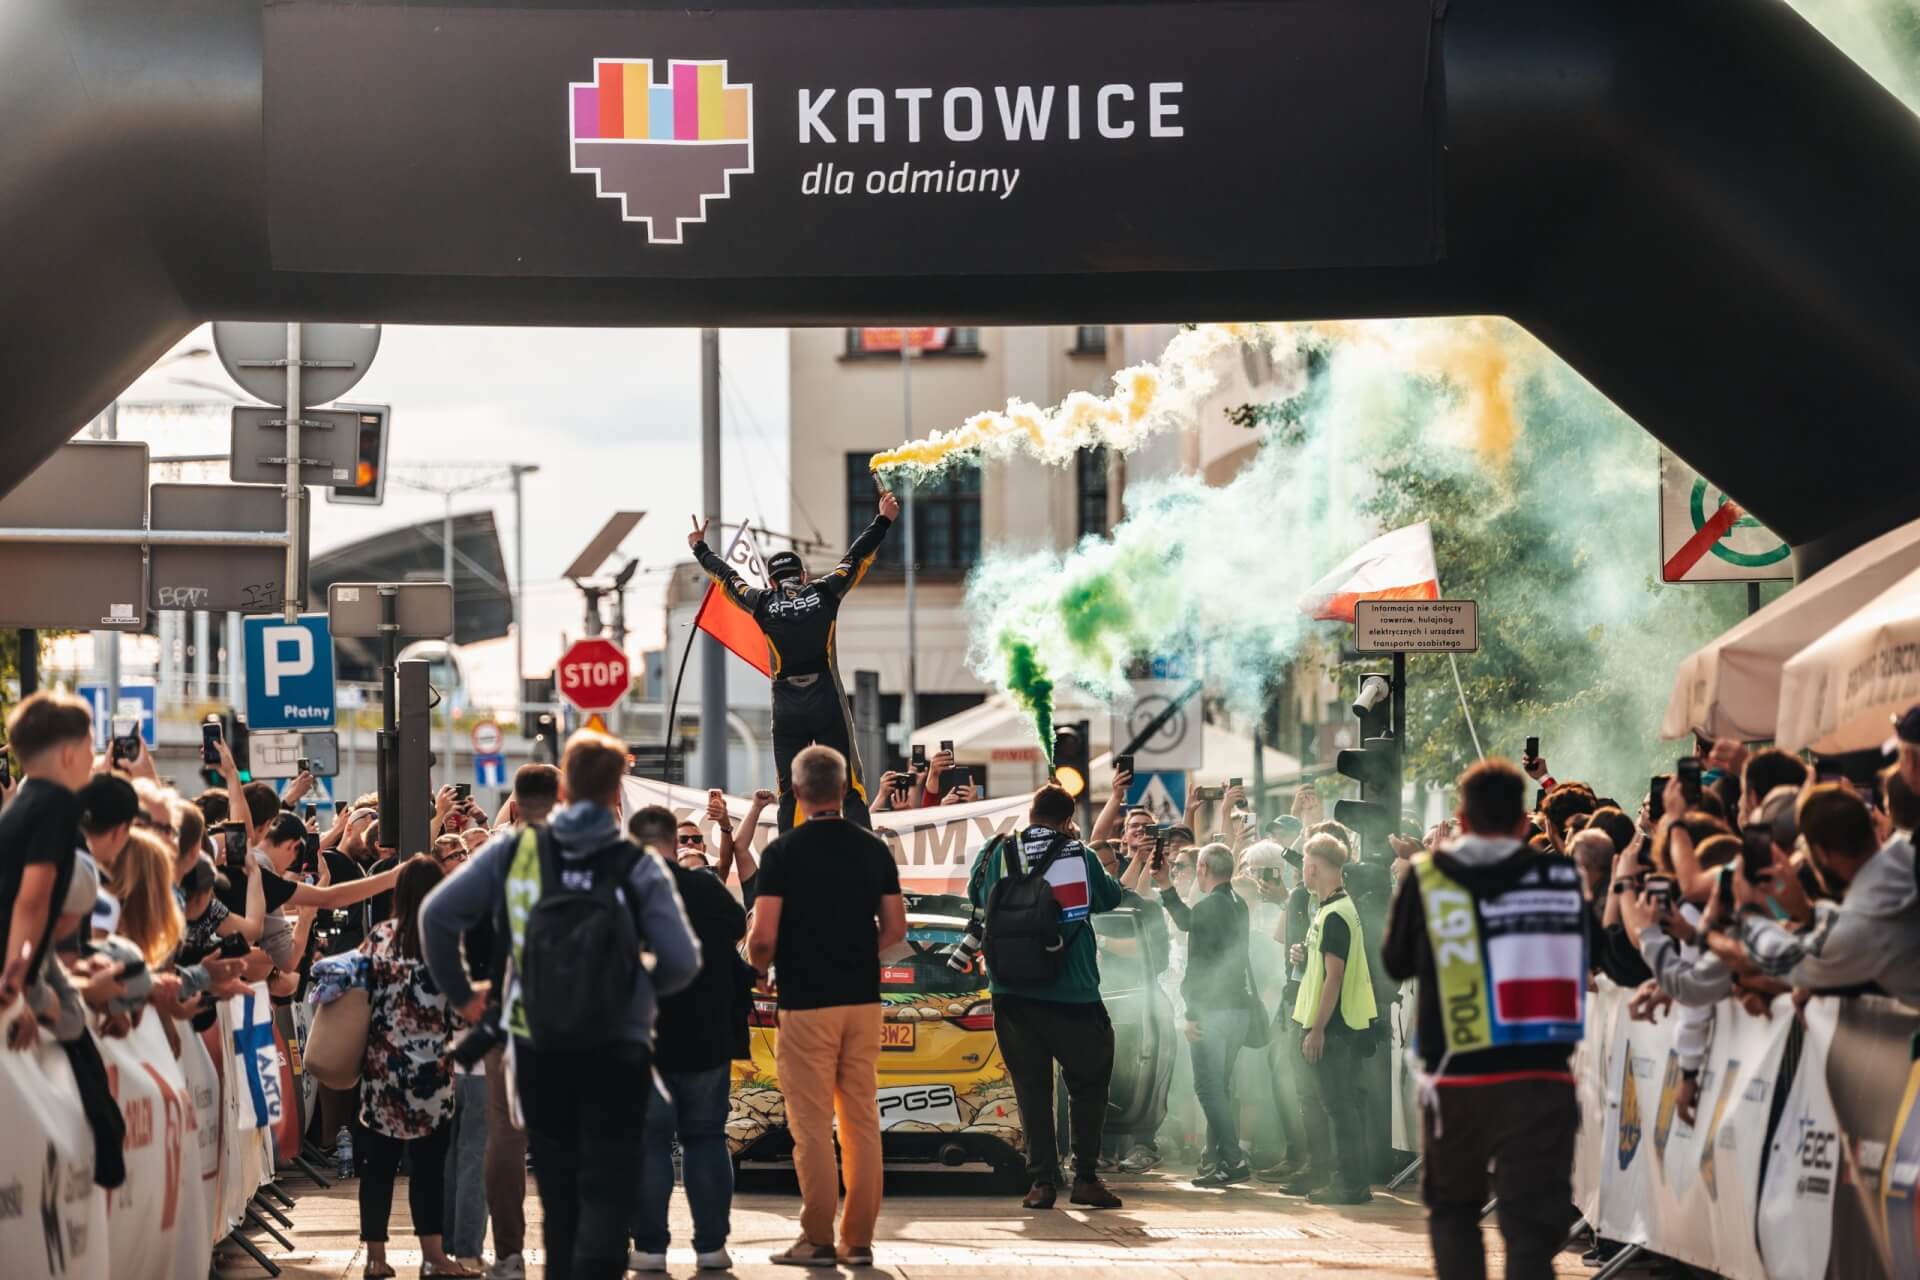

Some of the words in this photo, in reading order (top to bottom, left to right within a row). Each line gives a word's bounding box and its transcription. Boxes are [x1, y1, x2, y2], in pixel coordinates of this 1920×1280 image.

[798, 82, 1185, 144] KATOWICE
[801, 162, 855, 195] dla
[865, 160, 1021, 201] odmiany
[1371, 604, 1415, 613] Informacja
[1417, 604, 1429, 612] nie
[1432, 604, 1463, 613] dotyczy
[1418, 616, 1454, 625] hulajnóg
[1368, 628, 1422, 637] elektrycznych
[1430, 628, 1465, 637] urządzeń
[1373, 640, 1415, 648] transportu
[1417, 640, 1461, 648] osobistego
[262, 626, 315, 697] P
[564, 660, 625, 688] STOP
[283, 704, 331, 721] Płatny
[1429, 889, 1477, 967] 267
[1452, 978, 1481, 1047] POL
[878, 1087, 953, 1118] PGS
